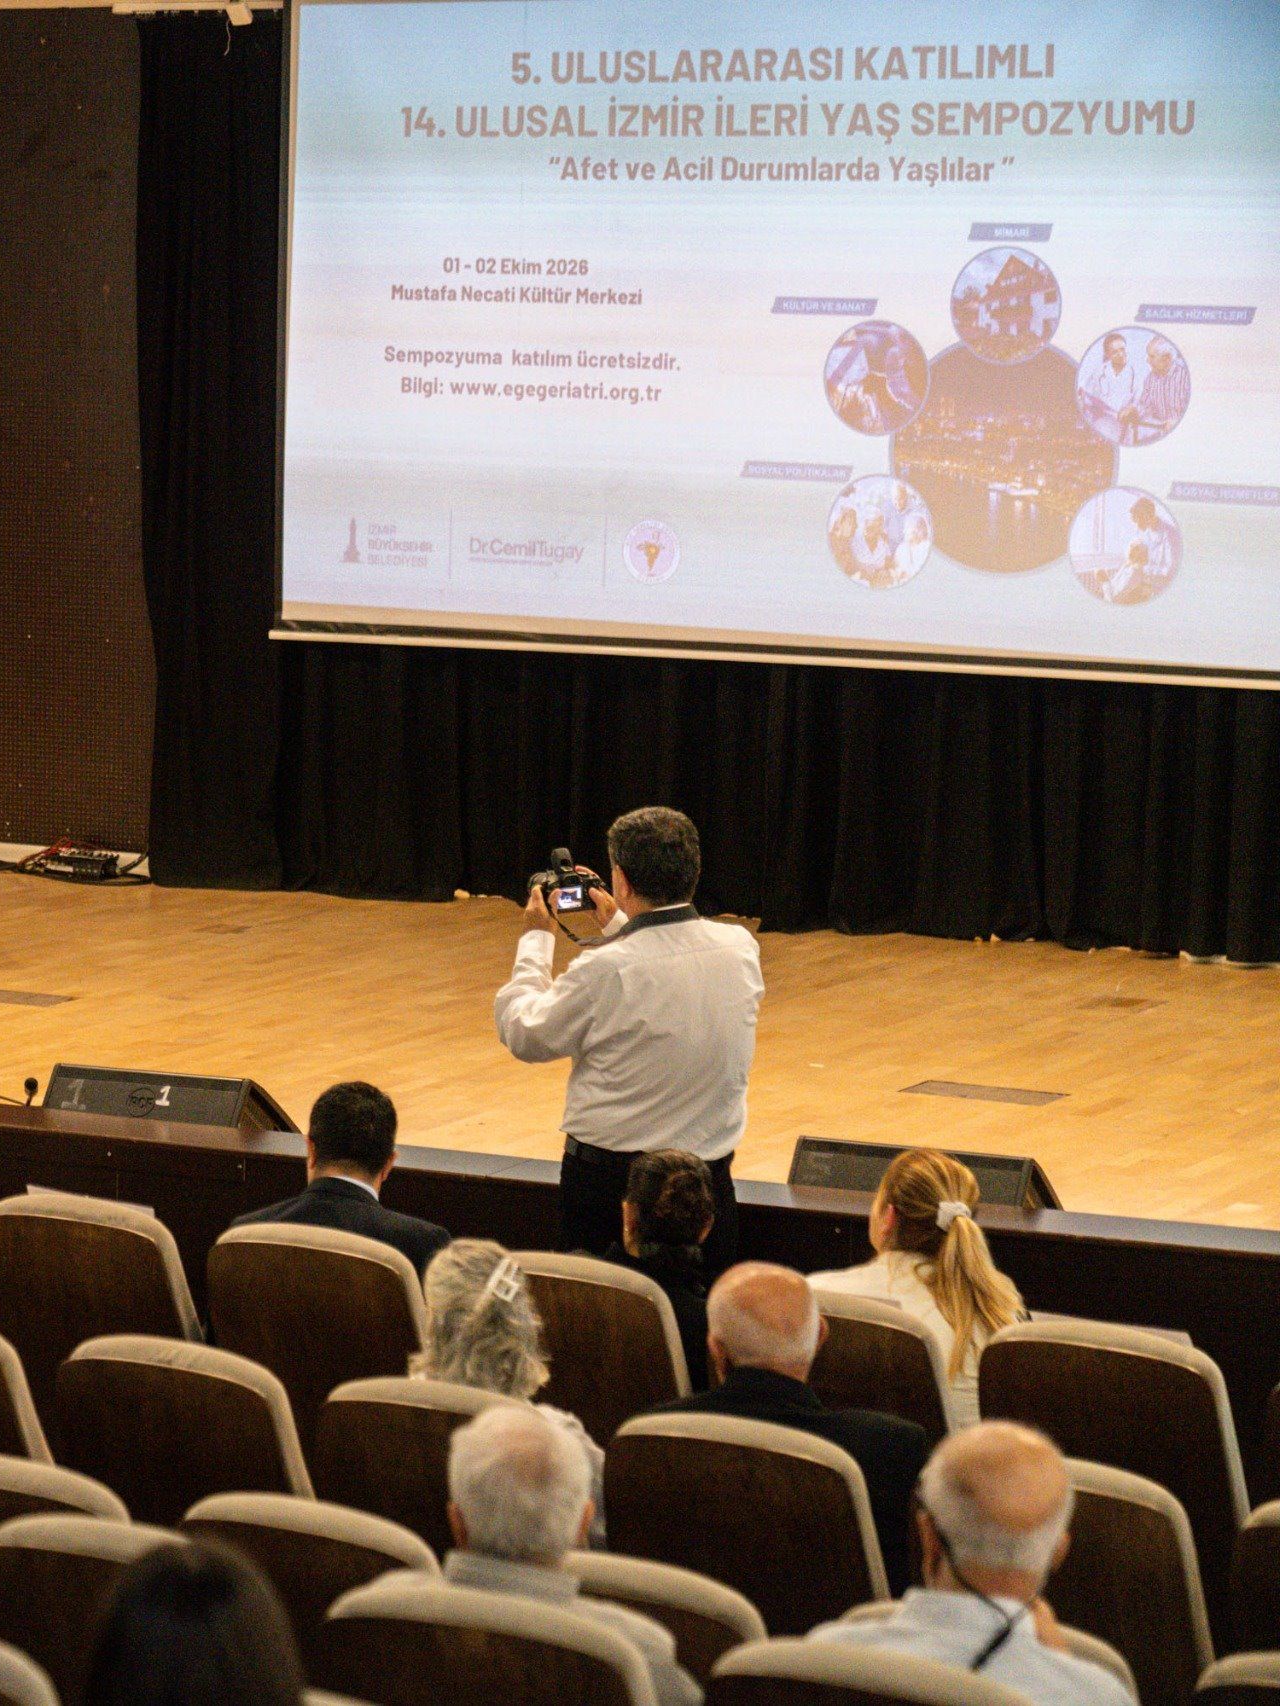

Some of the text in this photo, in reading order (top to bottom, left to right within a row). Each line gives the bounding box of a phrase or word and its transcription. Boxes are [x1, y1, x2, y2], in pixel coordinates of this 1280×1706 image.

[510, 43, 1055, 84] 5. ULUSLARARASI KATILIMLI
[401, 95, 1196, 145] 14. ULUSAL İZMİR İLERİ YAŞ SEMPOZYUMU
[625, 162, 656, 181] ve
[662, 156, 714, 182] Acil
[721, 156, 880, 182] Durumlarda
[888, 155, 995, 188] Yaşlılar
[442, 257, 460, 274] 01
[475, 258, 497, 275] 02
[500, 258, 542, 275] Ekim
[545, 259, 589, 276] 2026
[390, 285, 643, 305] Mustafa Necati Kültür Merkezi
[384, 345, 681, 371] Sempozyuma katılım ücretsizdir.
[400, 376, 662, 404] Bilgi: www.egegeriatri.org.tr
[154, 1085, 171, 1106] 1
